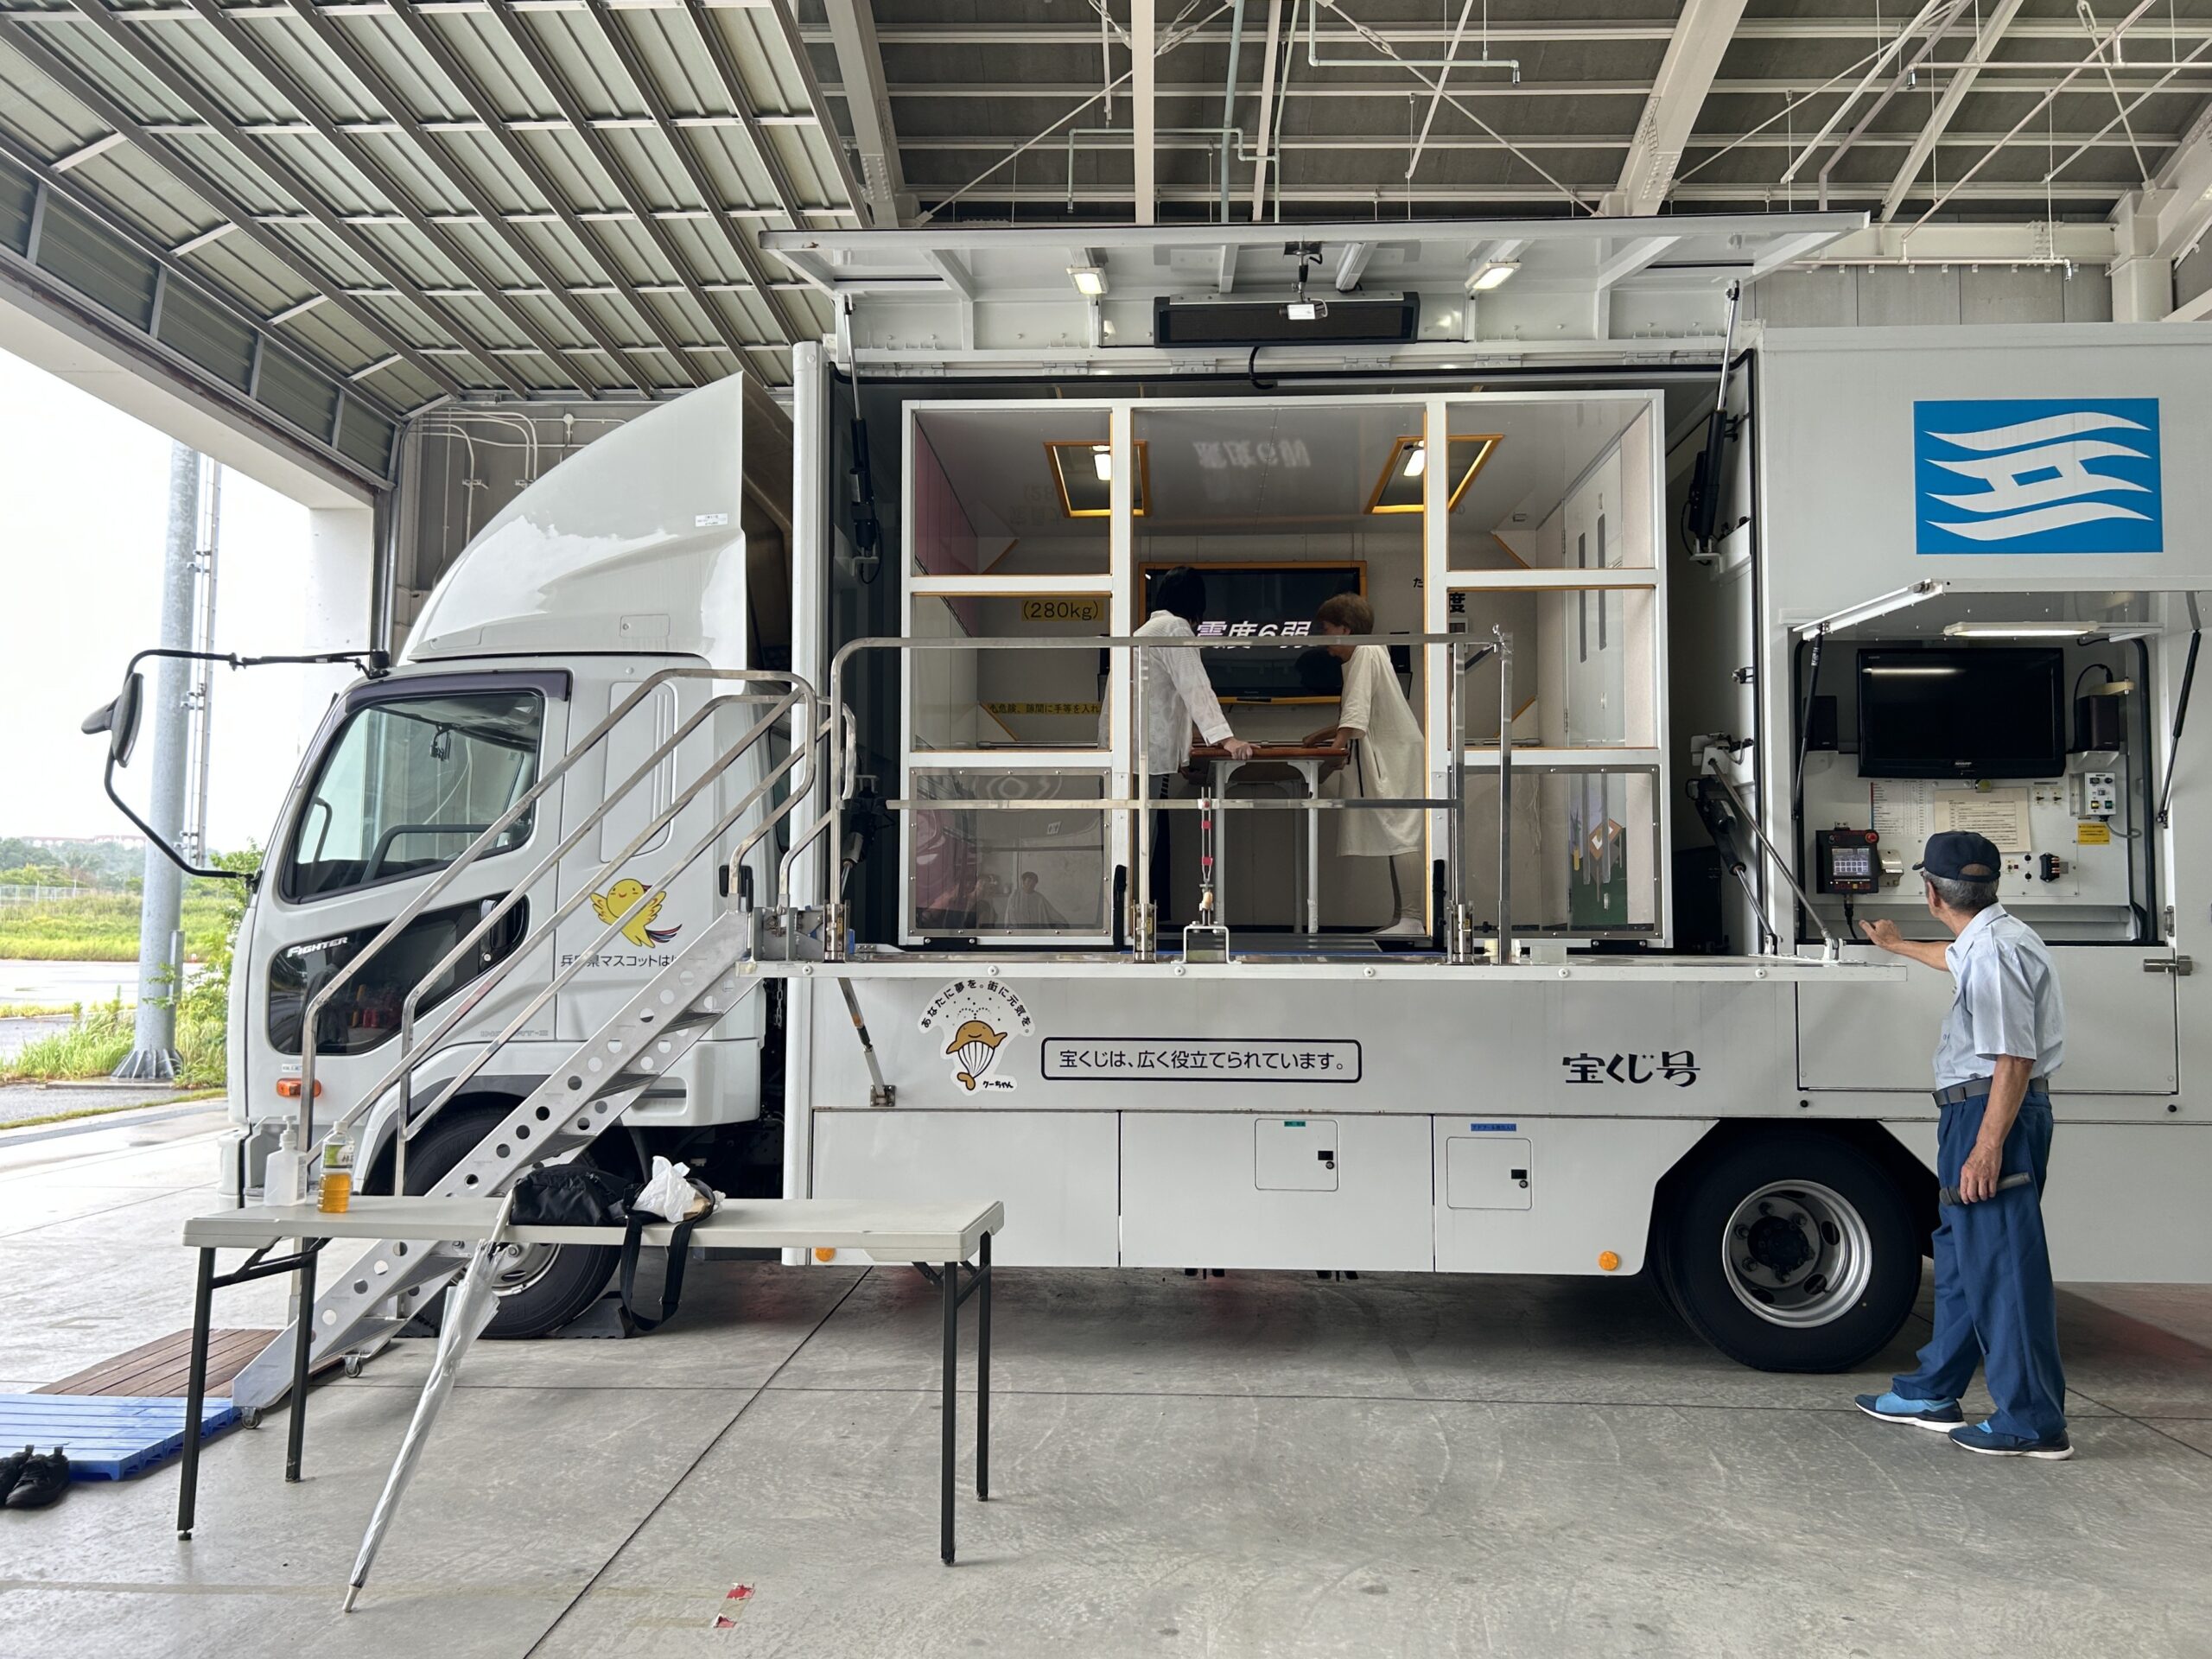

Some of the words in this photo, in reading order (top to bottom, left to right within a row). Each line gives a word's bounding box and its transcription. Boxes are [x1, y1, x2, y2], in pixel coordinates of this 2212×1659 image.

[1023, 601, 1099, 621] (280kg)
[287, 937, 348, 958] FIGHTER
[560, 954, 677, 968] 兵県マスコットは
[1059, 1049, 1344, 1071] 宝くじは、広く役立てられています。
[1562, 1050, 1701, 1088] 宝くじ号
